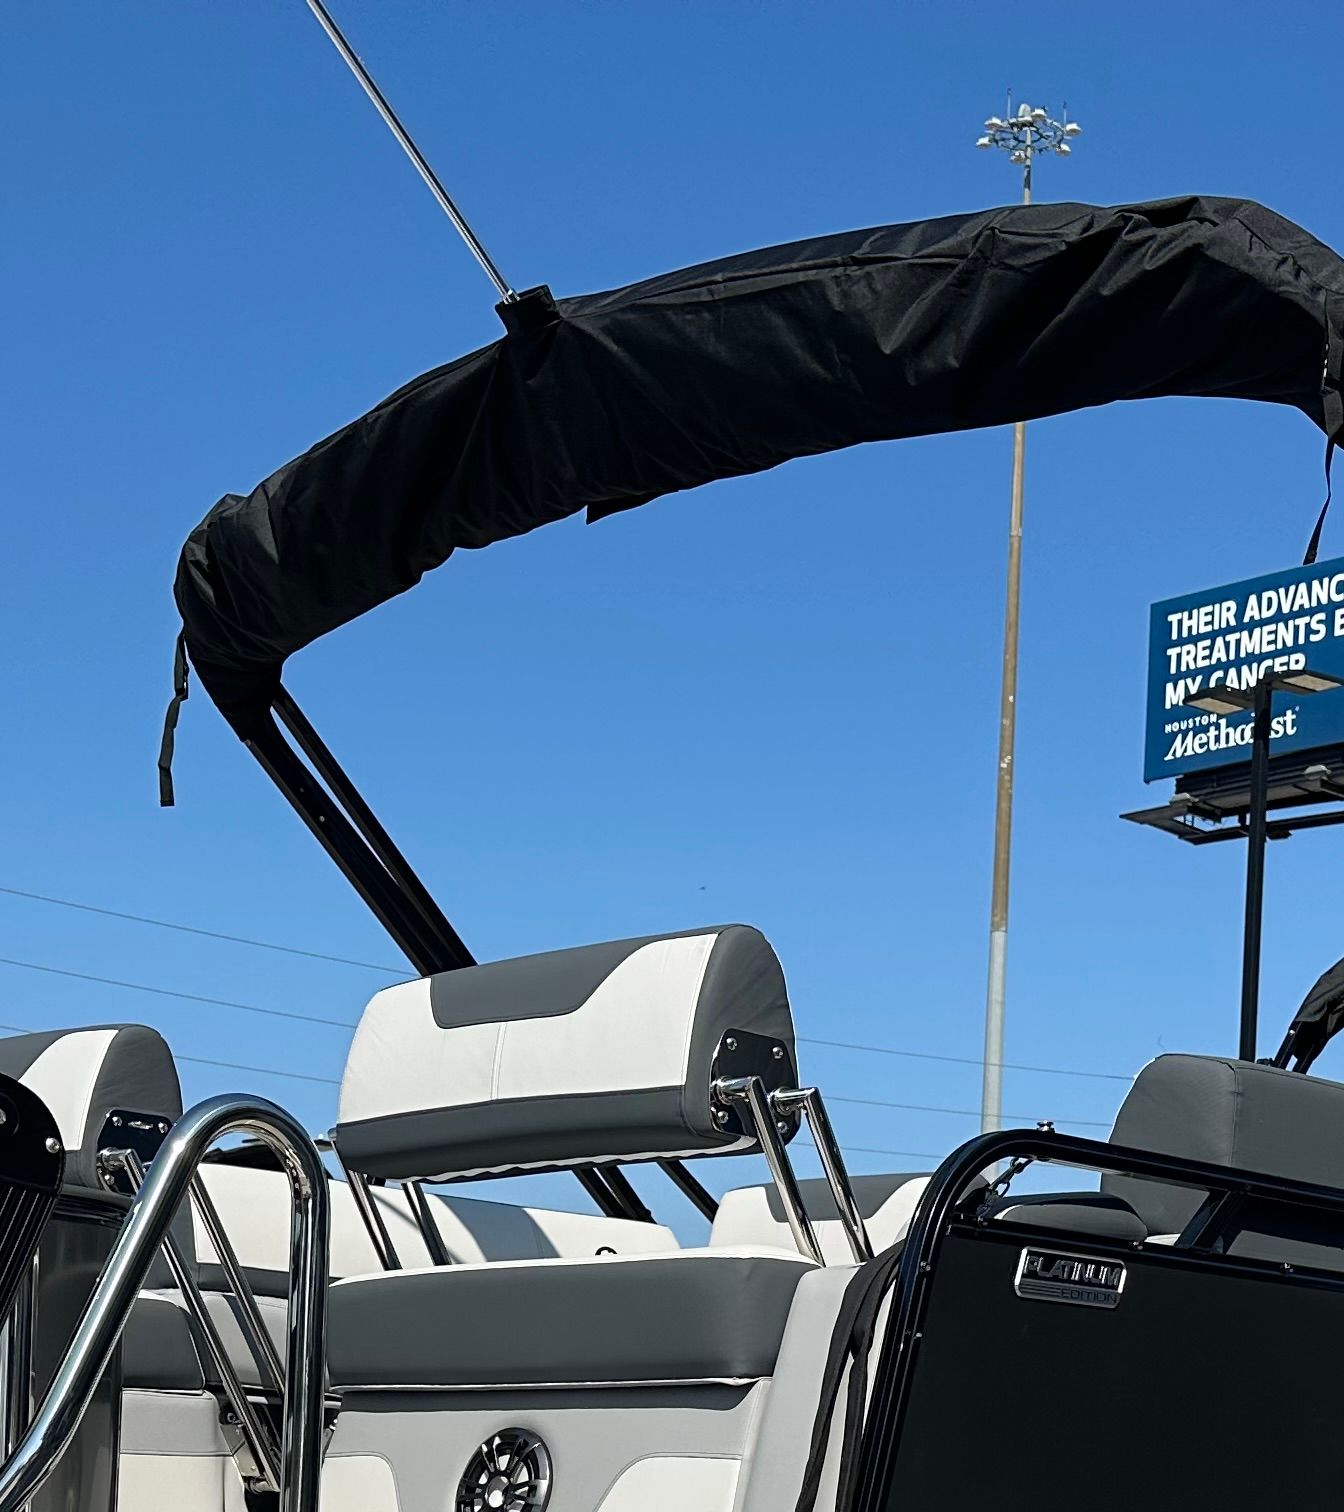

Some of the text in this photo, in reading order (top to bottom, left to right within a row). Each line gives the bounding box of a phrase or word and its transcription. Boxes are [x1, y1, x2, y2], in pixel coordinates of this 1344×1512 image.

[1167, 600, 1238, 641] THEIR
[1166, 612, 1327, 675] TREATMENTS
[1165, 675, 1203, 710] MY
[1164, 713, 1218, 734] HOUSTON
[1022, 1255, 1122, 1287] PLATINUM
[1060, 1287, 1118, 1305] EDITION
